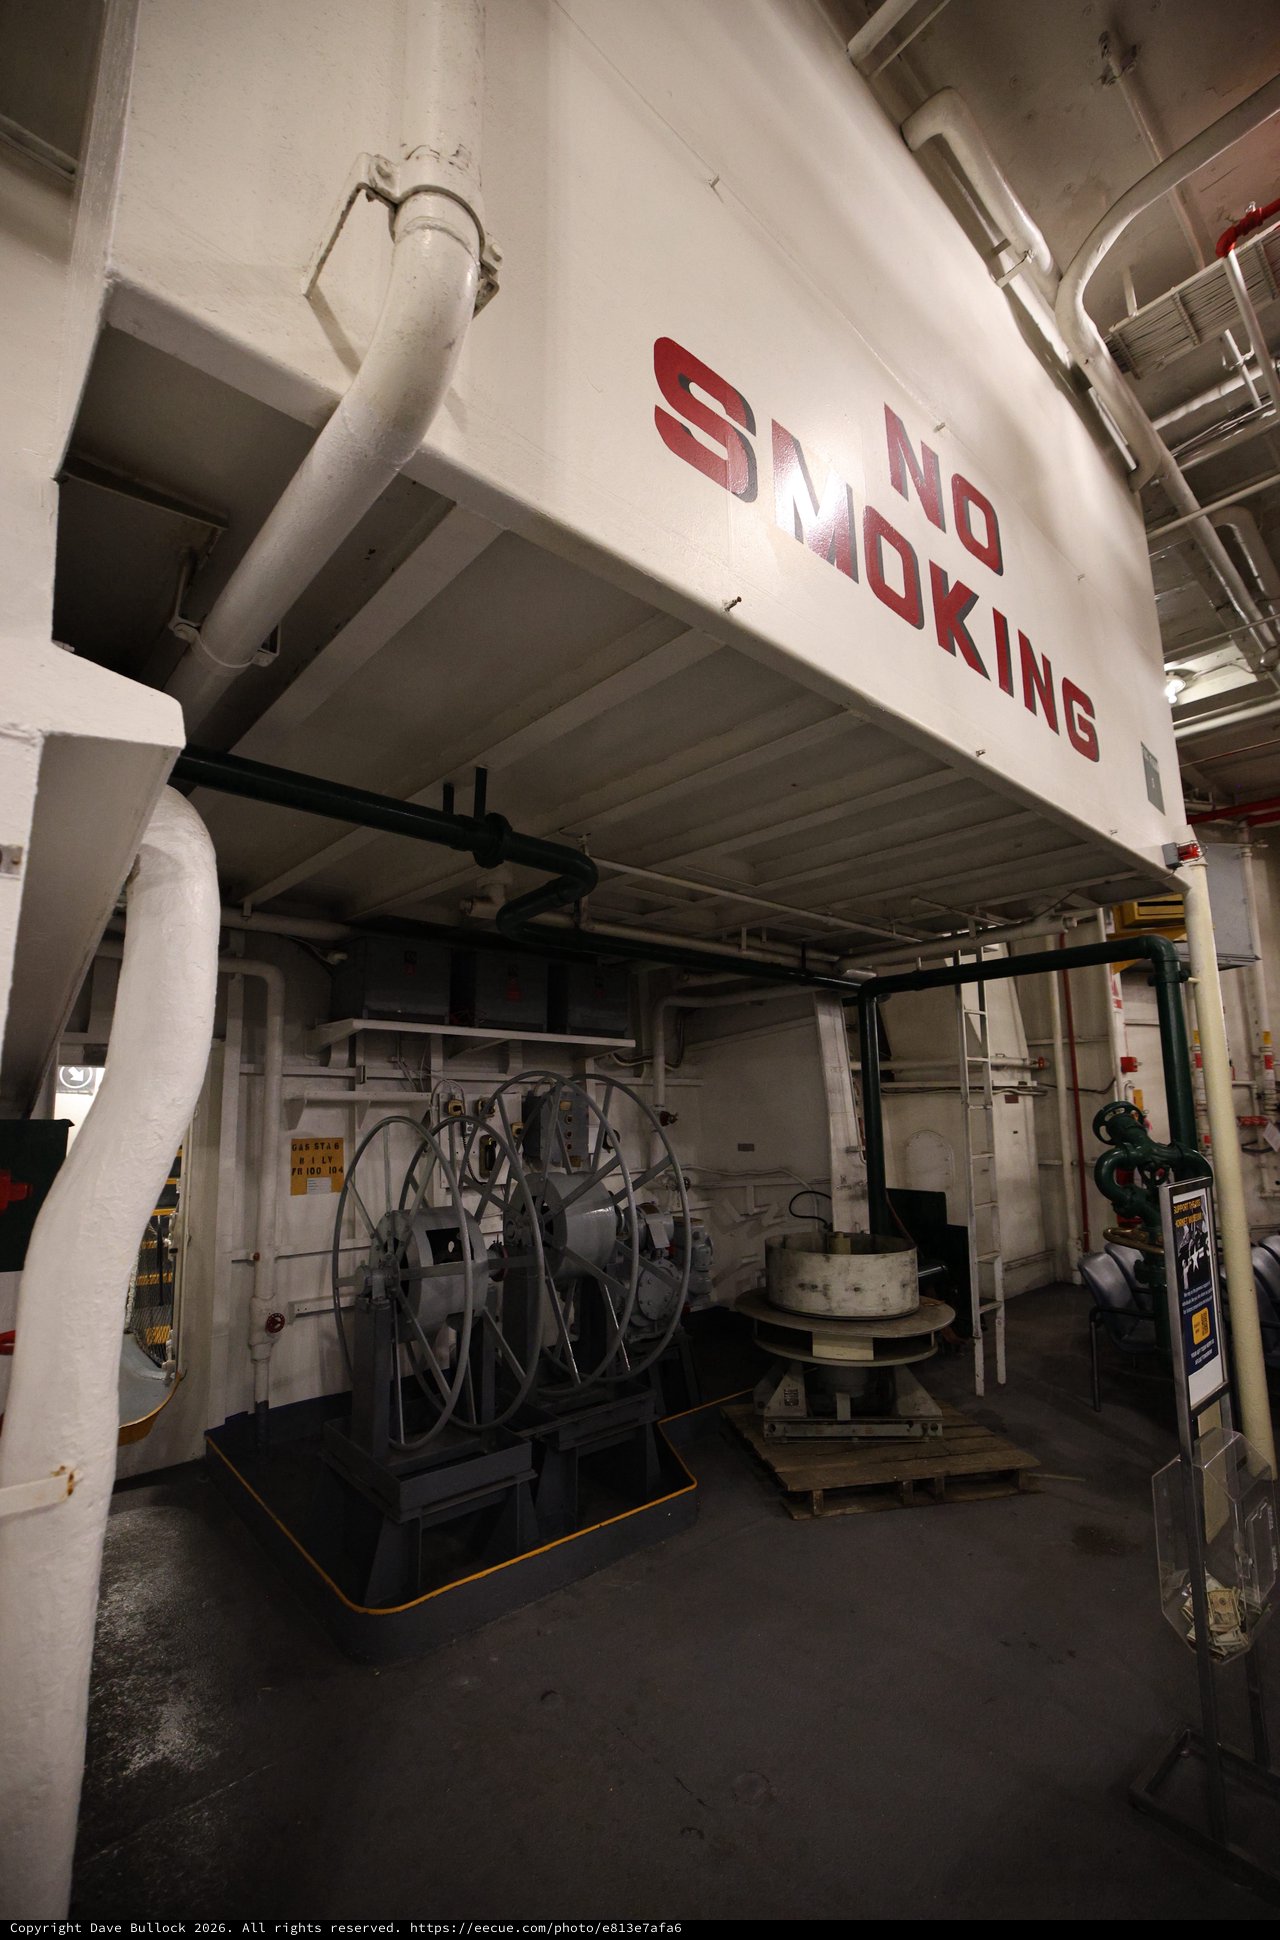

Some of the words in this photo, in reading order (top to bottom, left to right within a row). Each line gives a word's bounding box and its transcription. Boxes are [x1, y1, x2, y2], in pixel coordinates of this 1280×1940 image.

[884, 402, 1004, 577] NO
[653, 336, 1100, 762] SMOKING
[291, 1143, 310, 1152] GAS
[306, 1167, 322, 1175] 100
